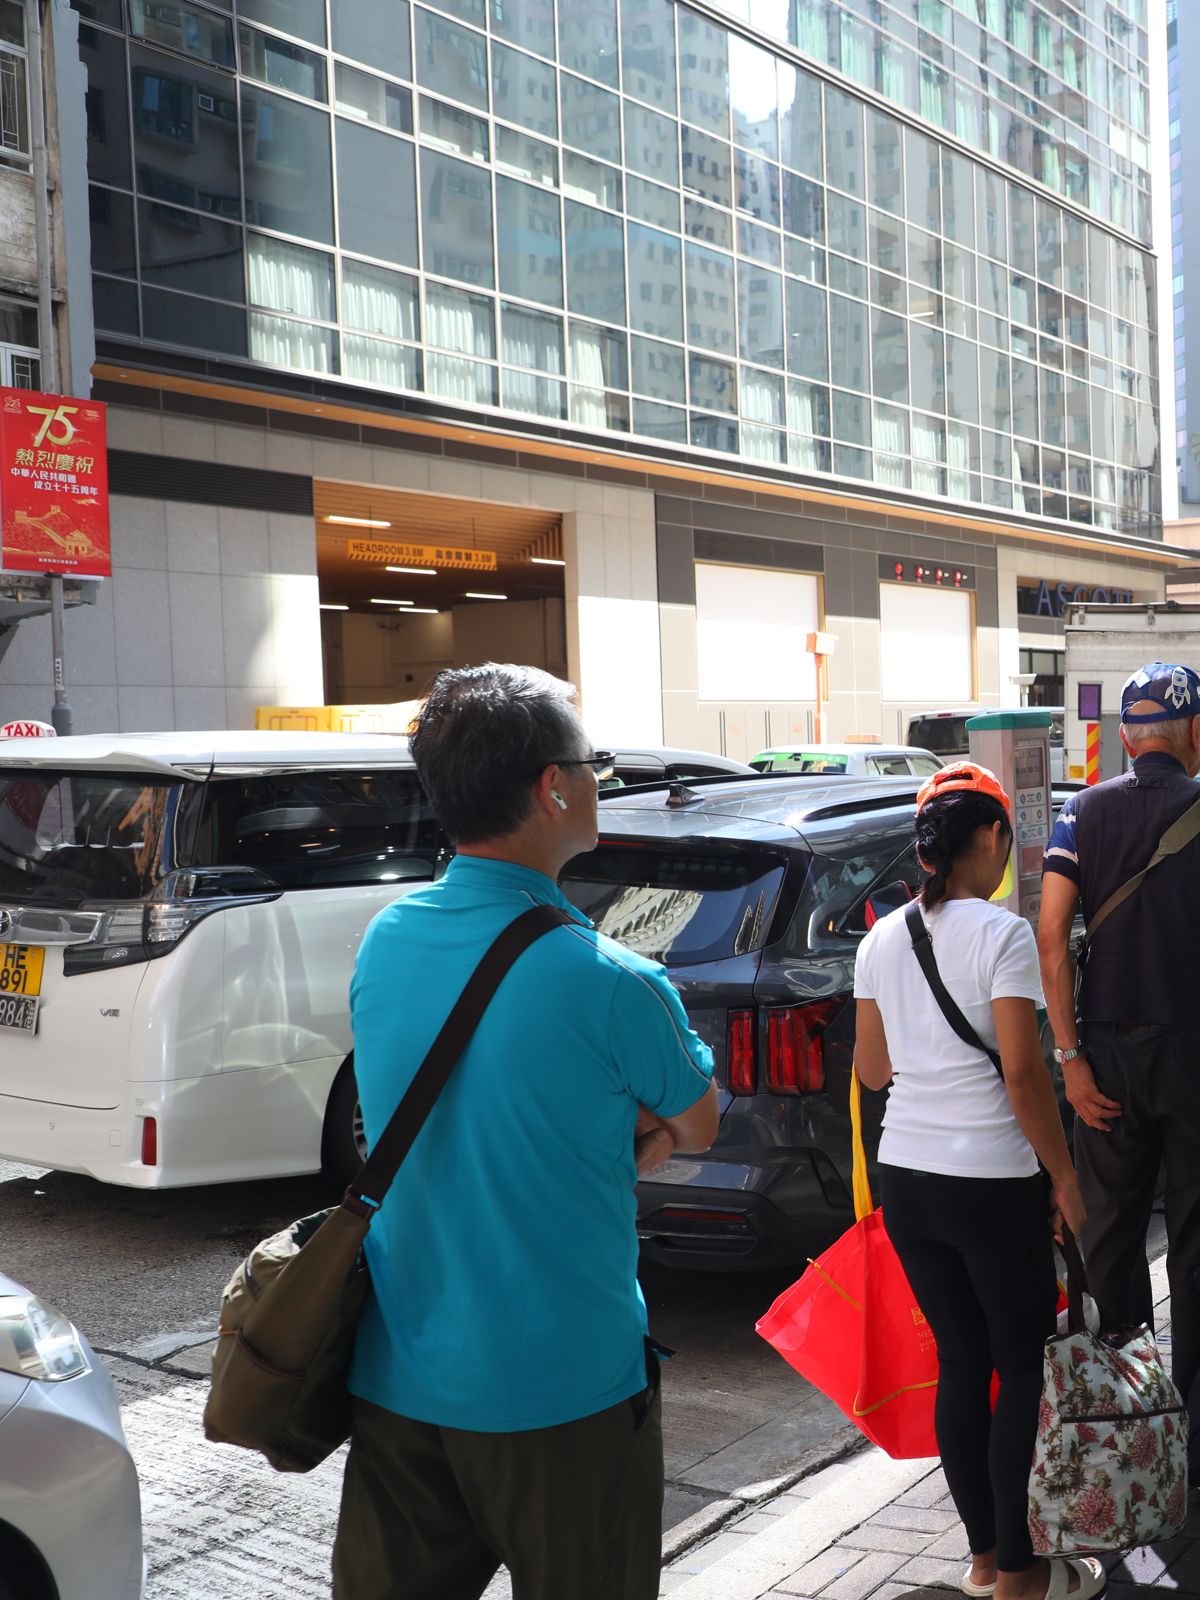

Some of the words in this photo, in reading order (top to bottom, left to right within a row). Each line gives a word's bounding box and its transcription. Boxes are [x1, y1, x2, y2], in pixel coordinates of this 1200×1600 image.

[26, 405, 79, 448] 75
[15, 448, 94, 475] 熱烈慶祝
[11, 467, 76, 483] 中華人民共和國
[34, 481, 98, 495] 成立七十五周年
[353, 543, 403, 555] HEADROOM
[4, 722, 40, 737] TAXI
[4, 945, 29, 970] HE
